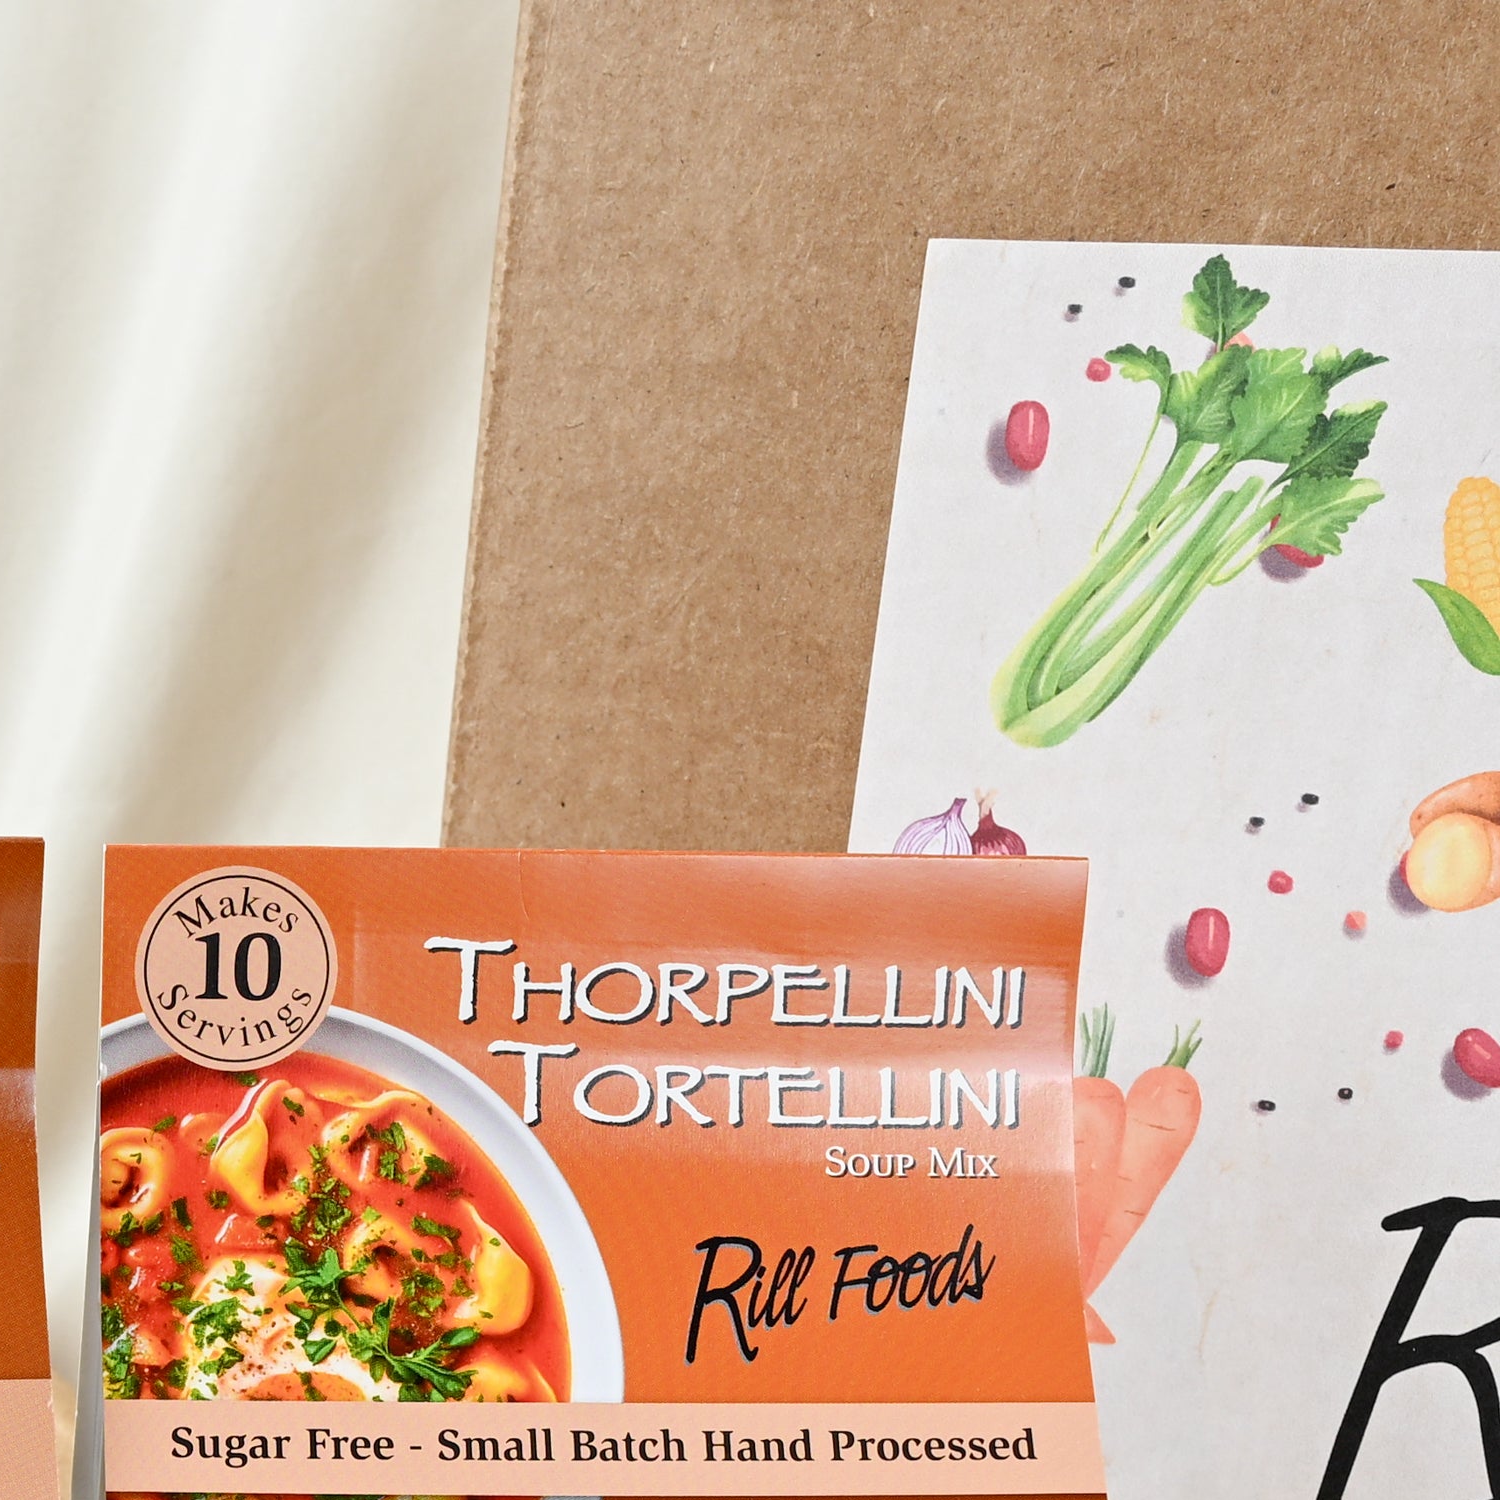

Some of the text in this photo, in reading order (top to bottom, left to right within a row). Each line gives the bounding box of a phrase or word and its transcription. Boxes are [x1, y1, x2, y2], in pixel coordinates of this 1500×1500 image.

[172, 887, 299, 938] Makes
[195, 932, 282, 1001] 10
[424, 936, 1025, 1028] THORPELLINI
[157, 983, 312, 1047] Servings
[488, 1040, 1021, 1129] TORTELLINI
[824, 1146, 998, 1178] SOUP MIX
[685, 1224, 995, 1365] Rill Foods
[171, 1426, 291, 1468] Sugar
[307, 1428, 394, 1460] Free
[438, 1428, 553, 1461] Small
[571, 1429, 687, 1461] Batch
[702, 1429, 815, 1461] Hand
[828, 1428, 1038, 1461] Processed
